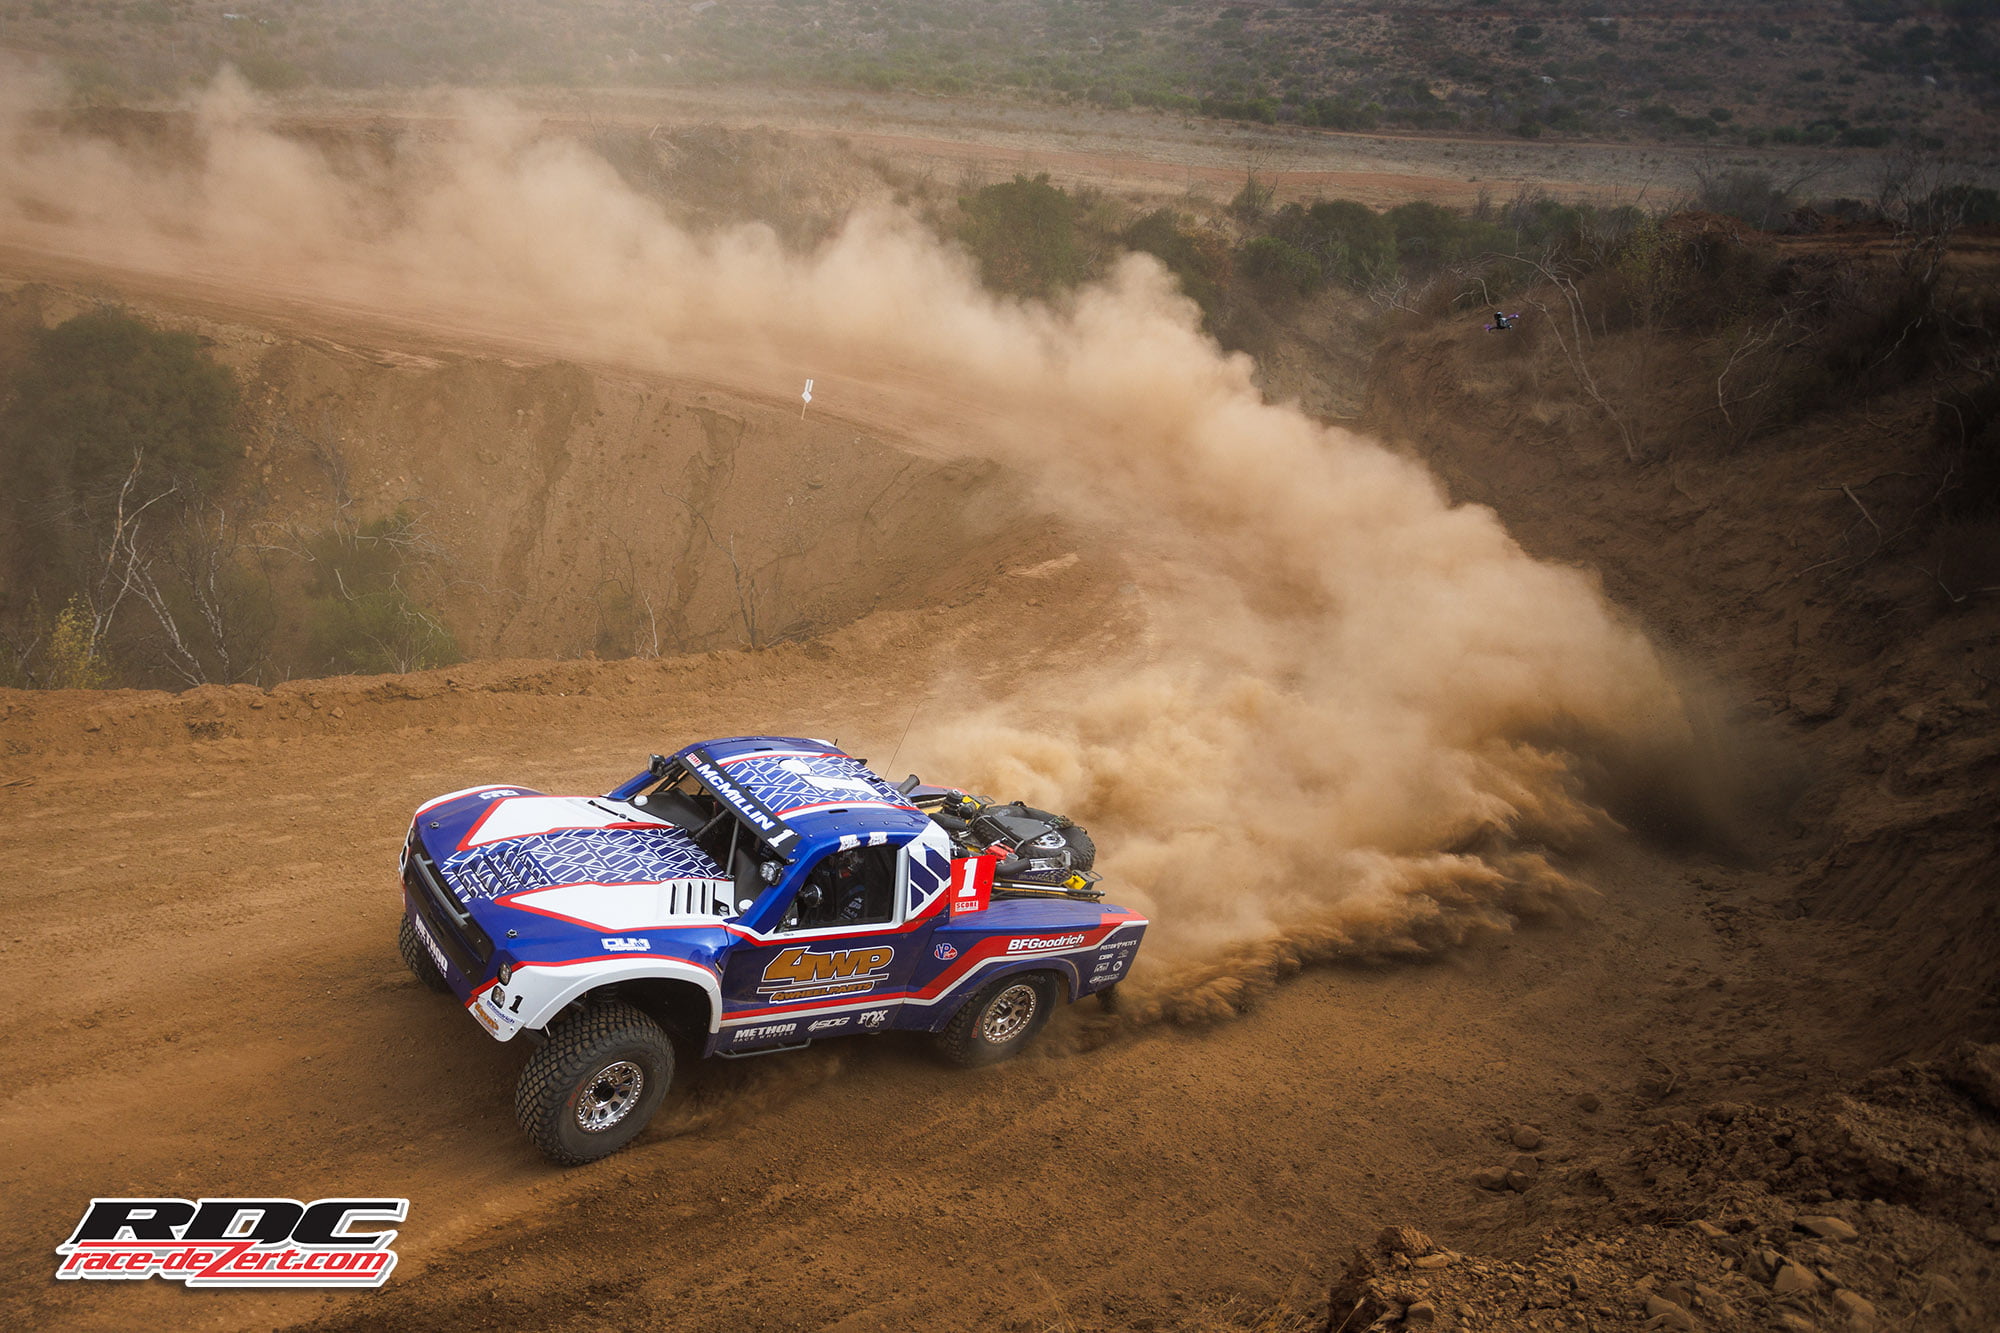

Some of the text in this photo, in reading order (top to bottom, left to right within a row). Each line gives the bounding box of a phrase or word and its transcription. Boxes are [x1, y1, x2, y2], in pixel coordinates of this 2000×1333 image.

[767, 829, 795, 848] 1
[957, 858, 978, 898] 1
[936, 942, 951, 959] VP
[1007, 934, 1085, 951] BFGoodrich
[762, 946, 894, 984] 4WP
[509, 995, 523, 1014] 1
[857, 1010, 888, 1028] FOX
[734, 1023, 797, 1039] METHOD
